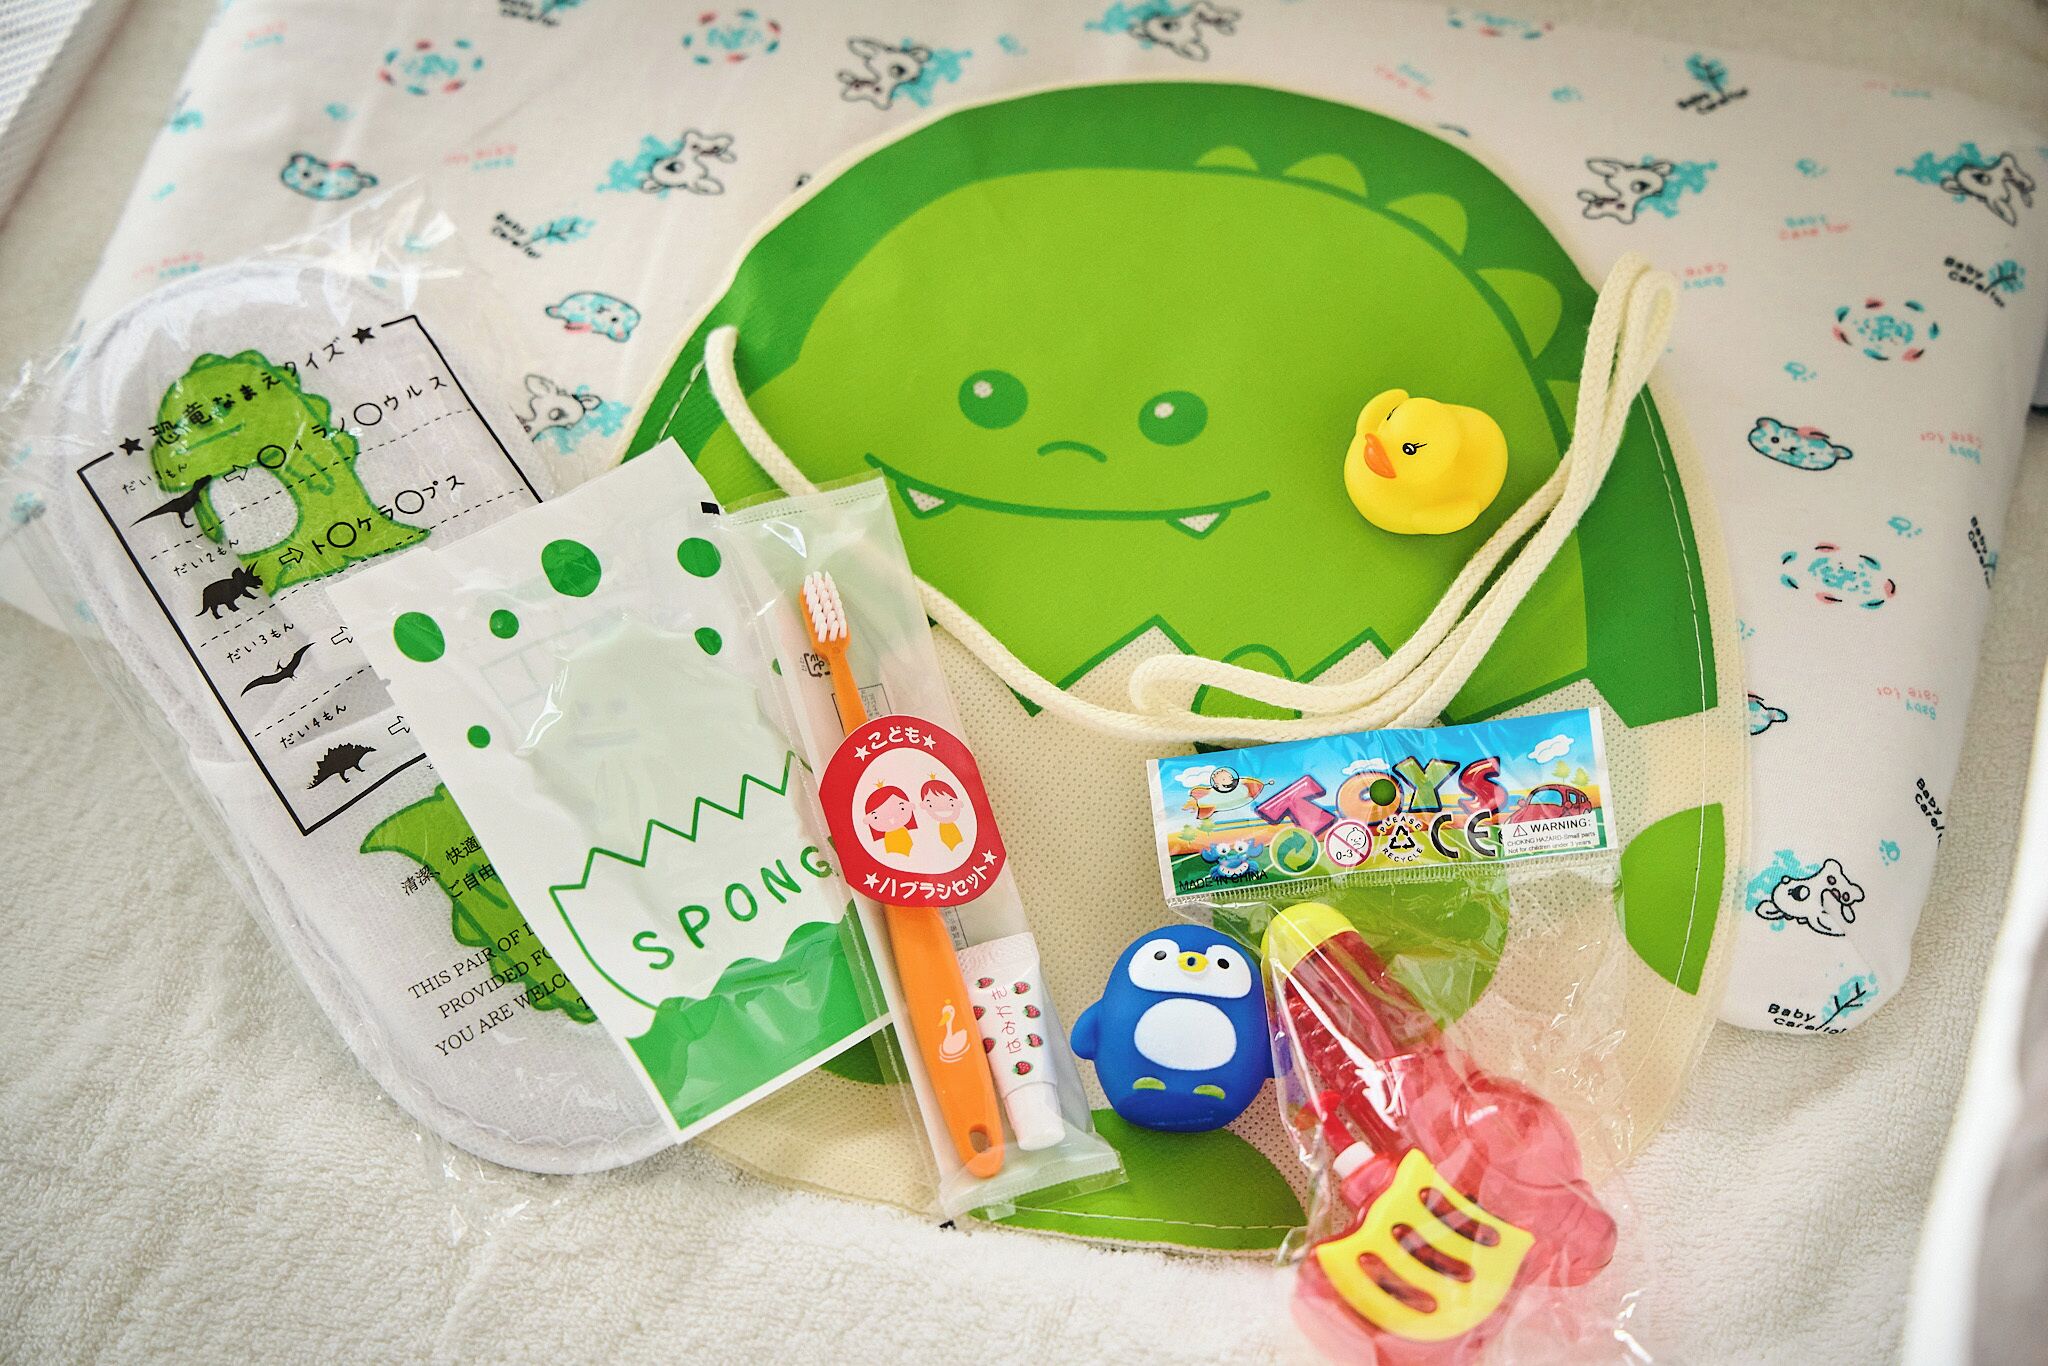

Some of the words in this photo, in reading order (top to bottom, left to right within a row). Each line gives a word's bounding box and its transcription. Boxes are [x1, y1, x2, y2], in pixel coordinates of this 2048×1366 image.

[173, 539, 239, 577] だい2もん
[227, 623, 294, 663] だい3もん
[280, 705, 346, 748] だい4もん
[867, 726, 920, 750] こども
[1254, 755, 1508, 837] TOYS
[1916, 778, 1942, 815] Baby
[1380, 815, 1422, 833] PLEASE
[1507, 837, 1535, 846] CHOKING
[1581, 831, 1596, 839] parts
[1530, 818, 1591, 833] WARNING:
[1336, 850, 1353, 861] 0-3
[1382, 847, 1424, 862] RECYCLE
[1528, 843, 1551, 851] children
[448, 863, 499, 898] ご自由
[878, 865, 988, 900] ハブラシセット
[1178, 877, 1213, 891] MADE
[1216, 876, 1228, 886] IN
[1231, 869, 1268, 883] CHINA
[631, 836, 837, 970] SPONG
[408, 970, 451, 999] THIS
[453, 947, 497, 977] PAIR
[497, 929, 520, 952] OF
[438, 961, 529, 1019] PROVIDED
[435, 1025, 474, 1056] YOU
[479, 1003, 514, 1033] ARE
[1768, 1003, 1816, 1022] Baby
